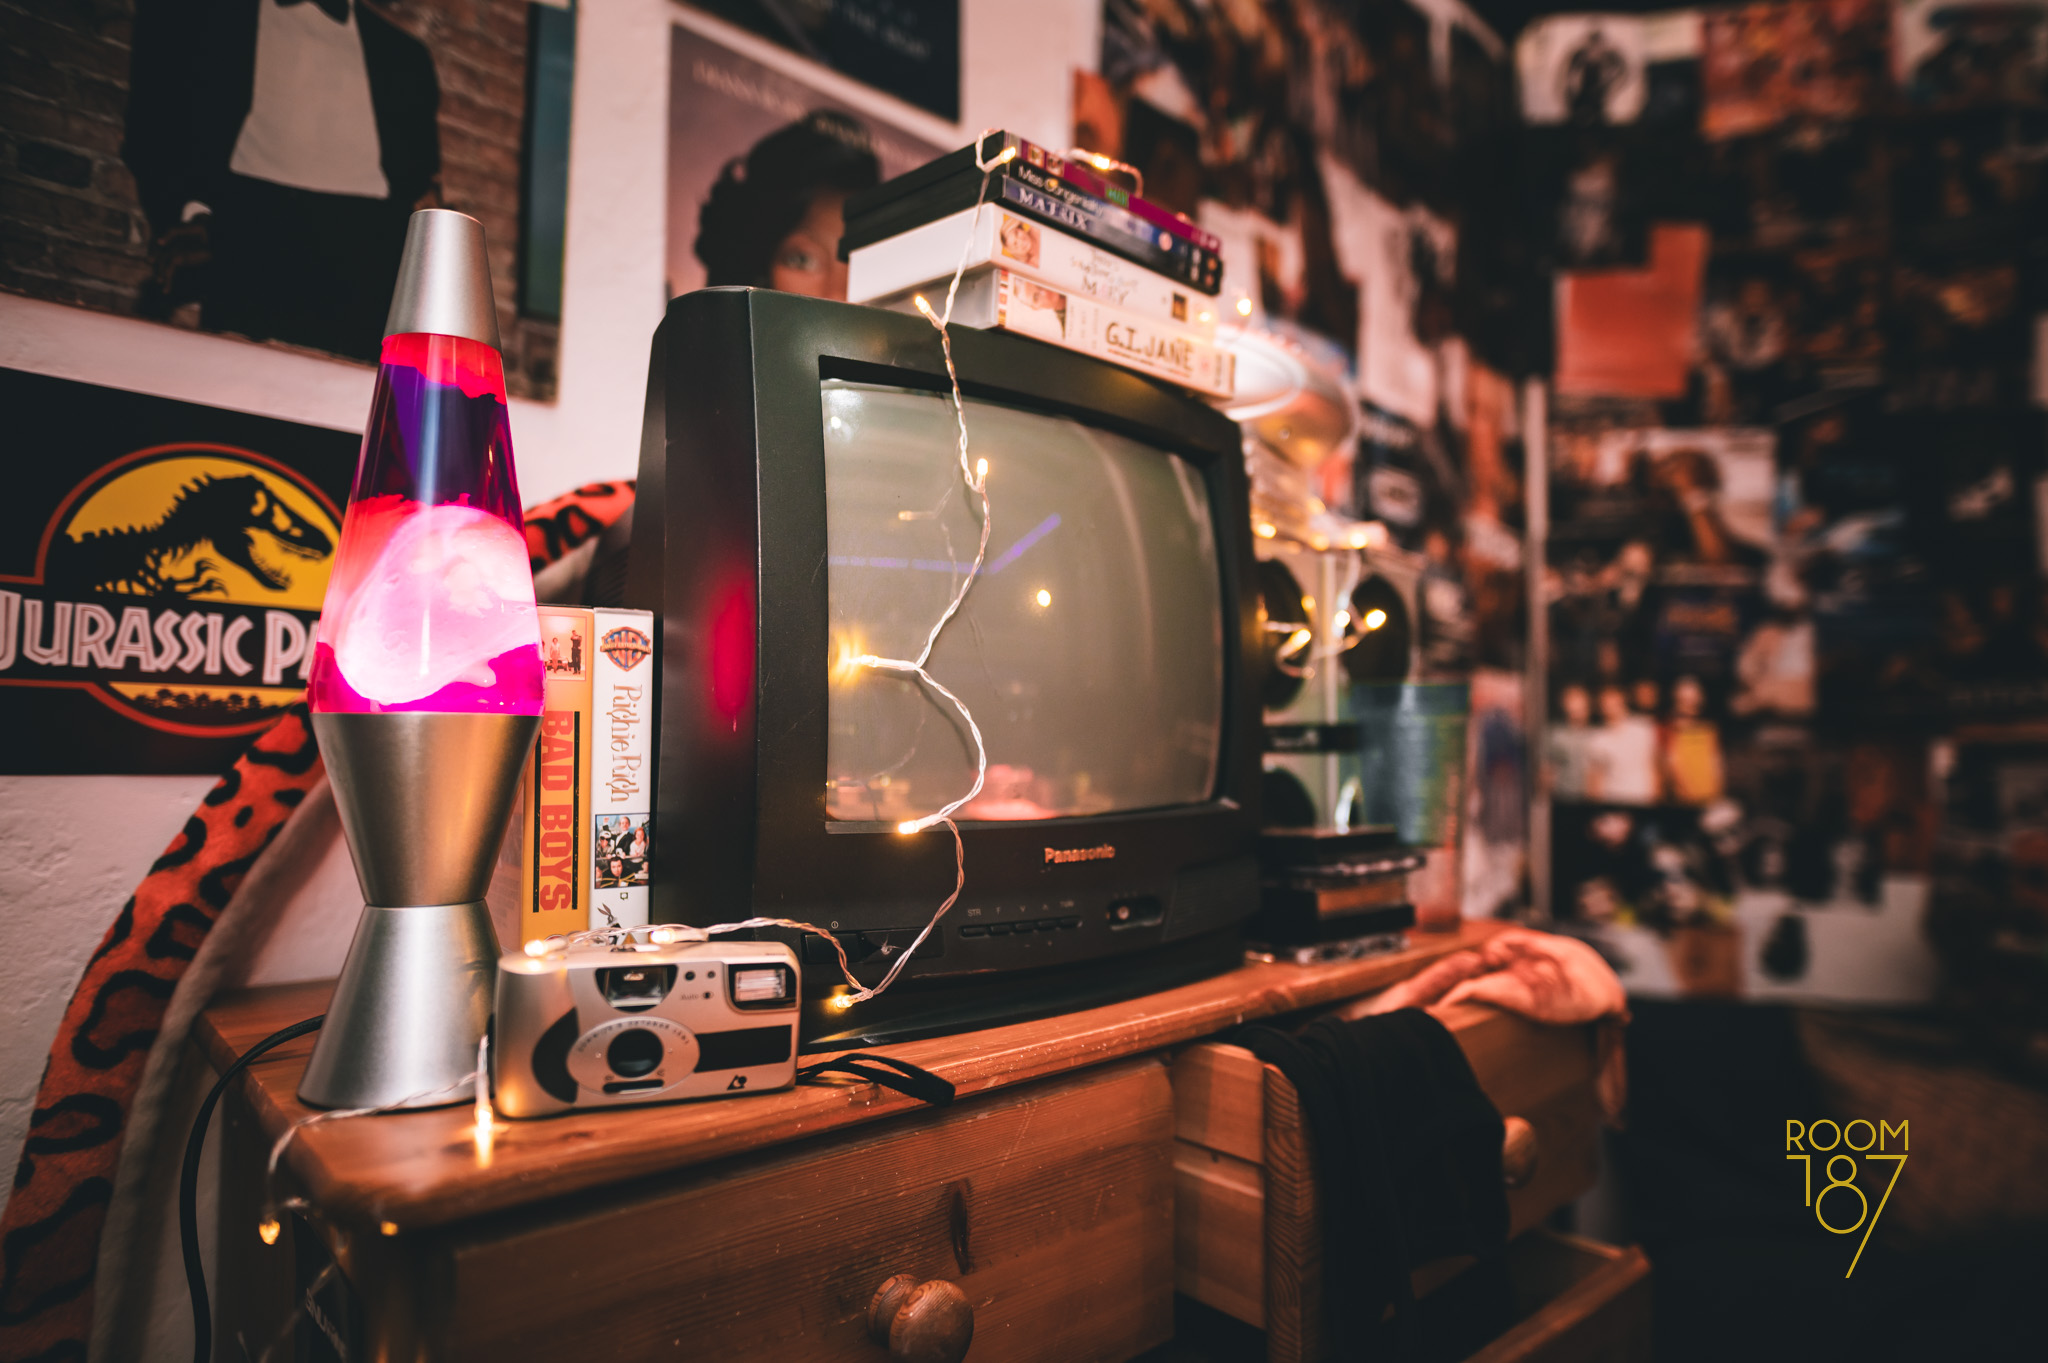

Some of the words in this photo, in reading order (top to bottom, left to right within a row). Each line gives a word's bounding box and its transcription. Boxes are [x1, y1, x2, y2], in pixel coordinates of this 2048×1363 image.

[1018, 165, 1045, 188] Miss
[1018, 187, 1089, 231] MATRIX
[1144, 335, 1194, 371] JANE
[0, 589, 253, 677] JURASSIC
[606, 684, 642, 752] Richie
[541, 710, 574, 791] BAD
[606, 753, 642, 803] Rich
[540, 804, 573, 911] BOYS
[1044, 844, 1116, 863] Panasonic
